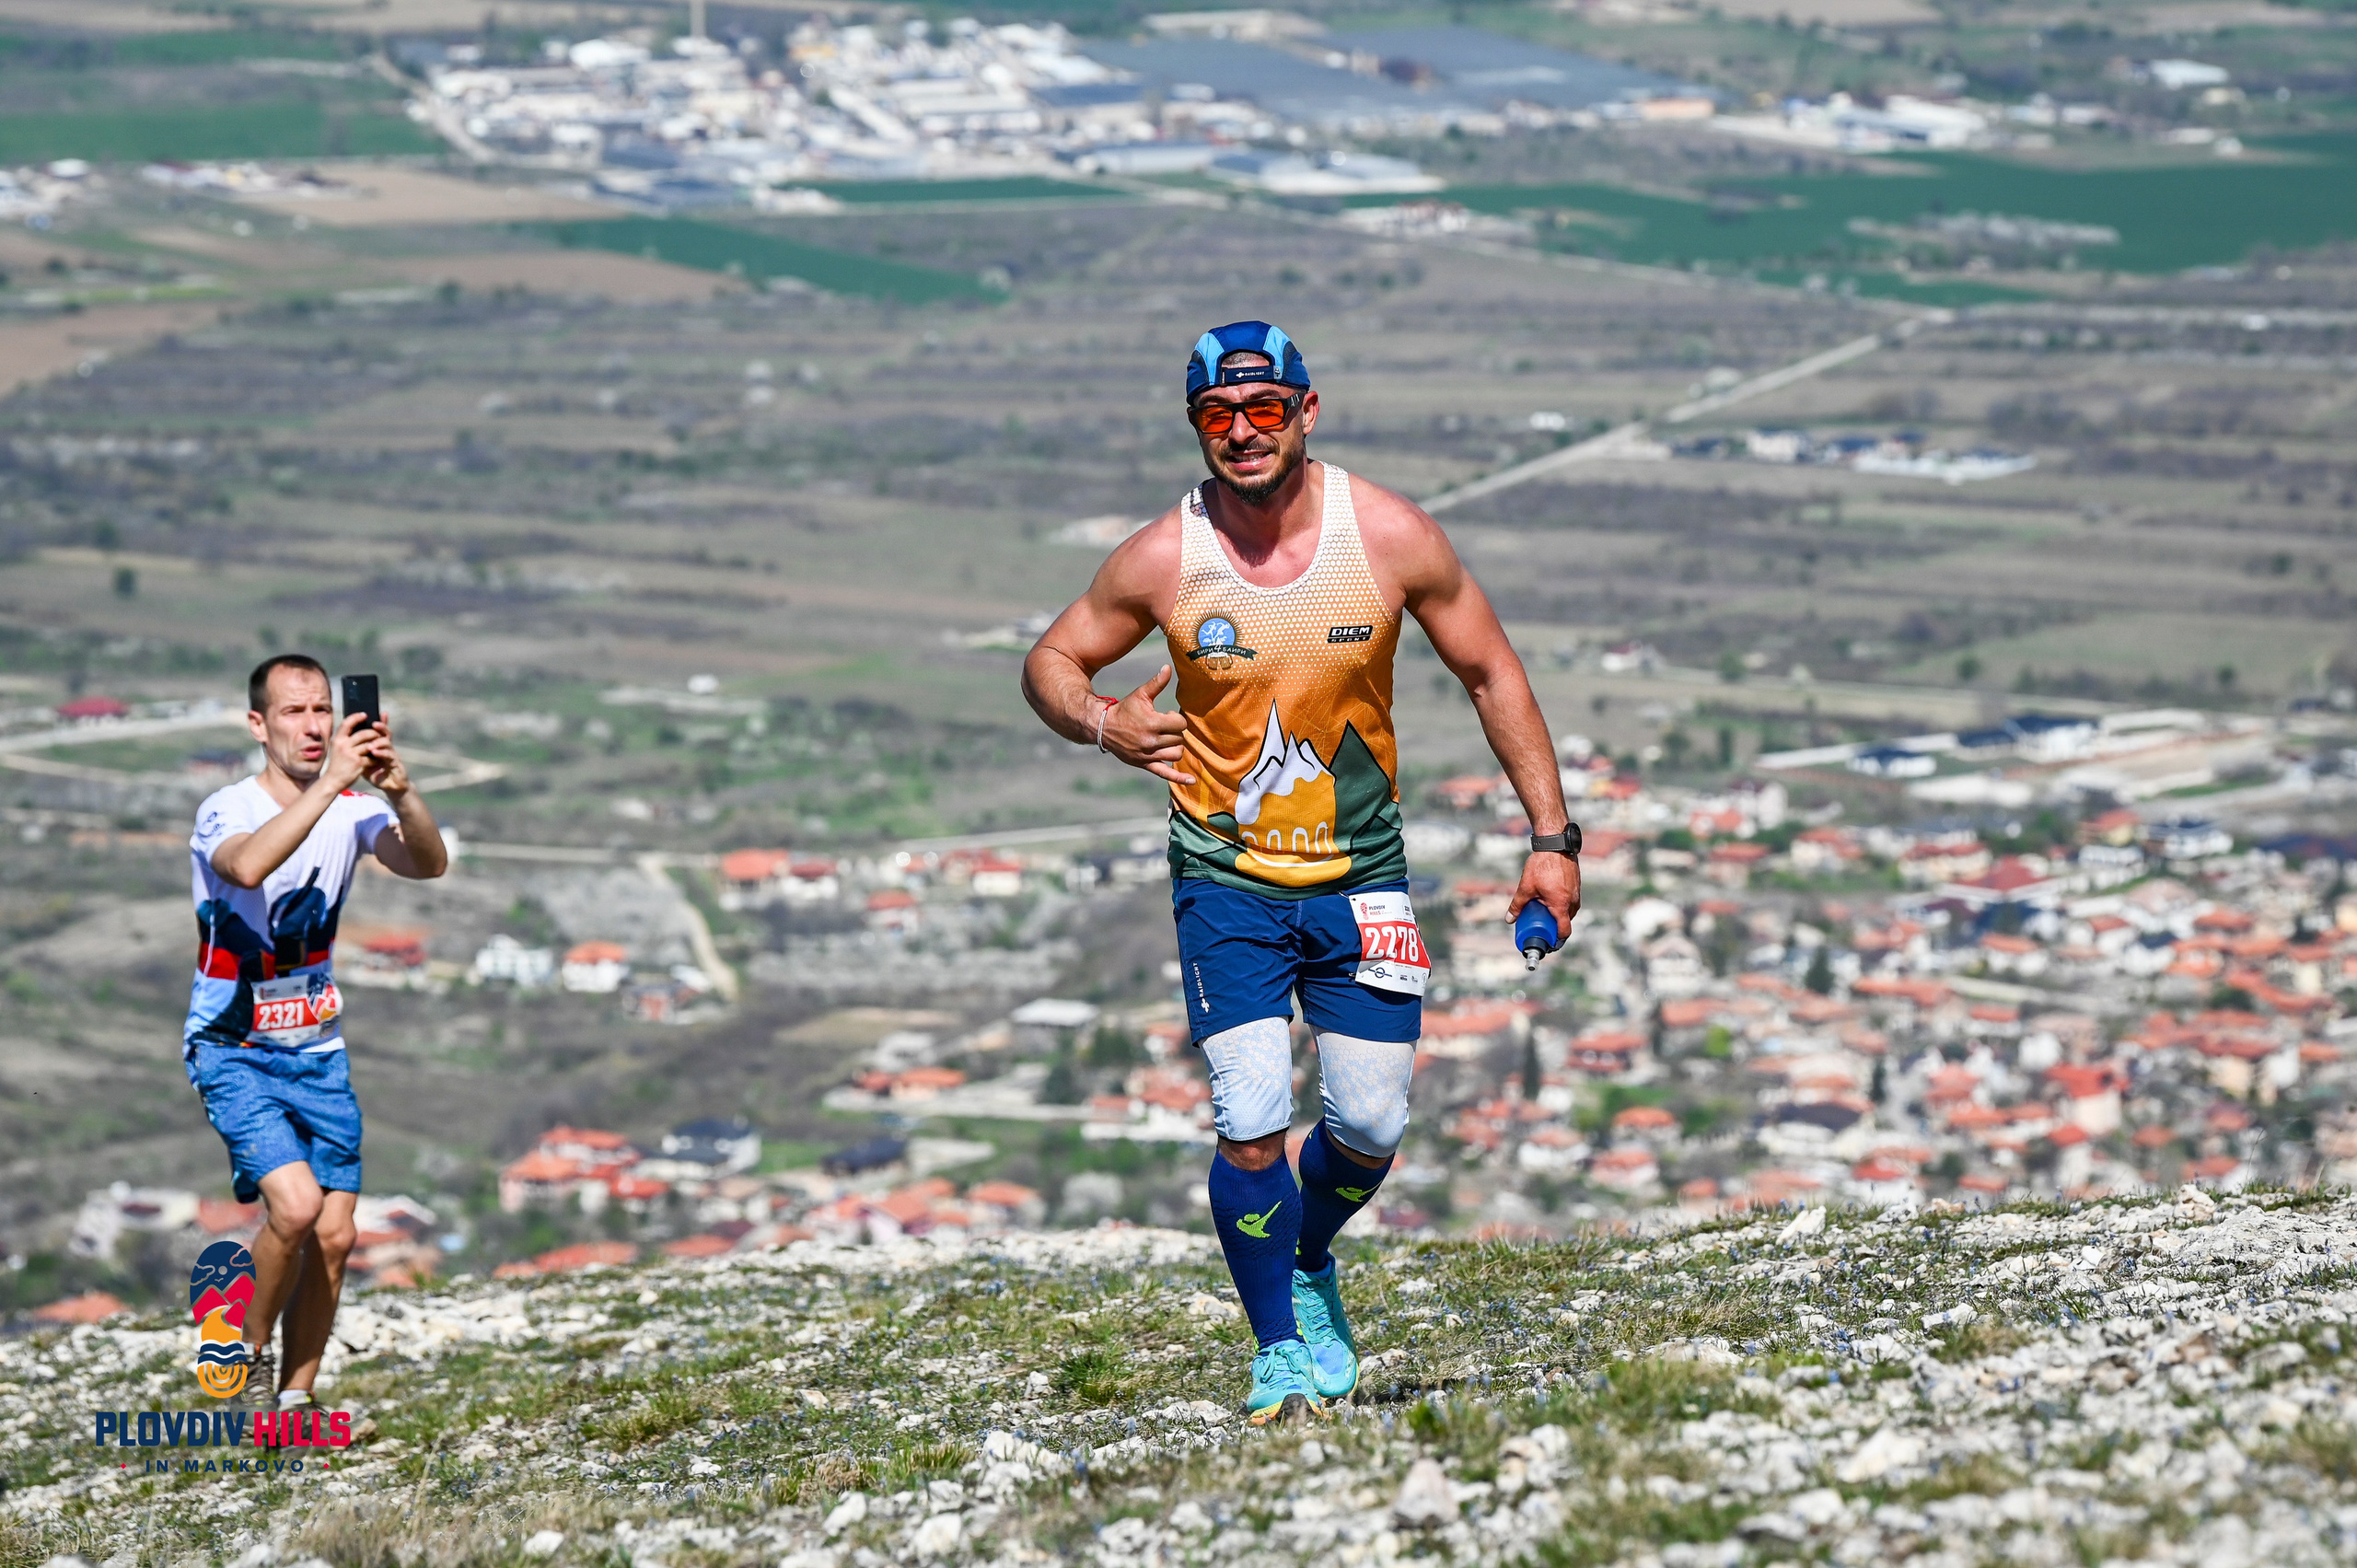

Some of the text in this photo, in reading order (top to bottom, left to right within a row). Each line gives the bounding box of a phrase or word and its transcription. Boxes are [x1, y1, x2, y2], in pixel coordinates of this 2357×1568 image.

[1330, 626, 1370, 636] DIEM
[1214, 645, 1222, 653] 4
[1364, 925, 1419, 962] 2278
[1193, 963, 1203, 997] RAIDLIGHT
[257, 1001, 305, 1030] 2321
